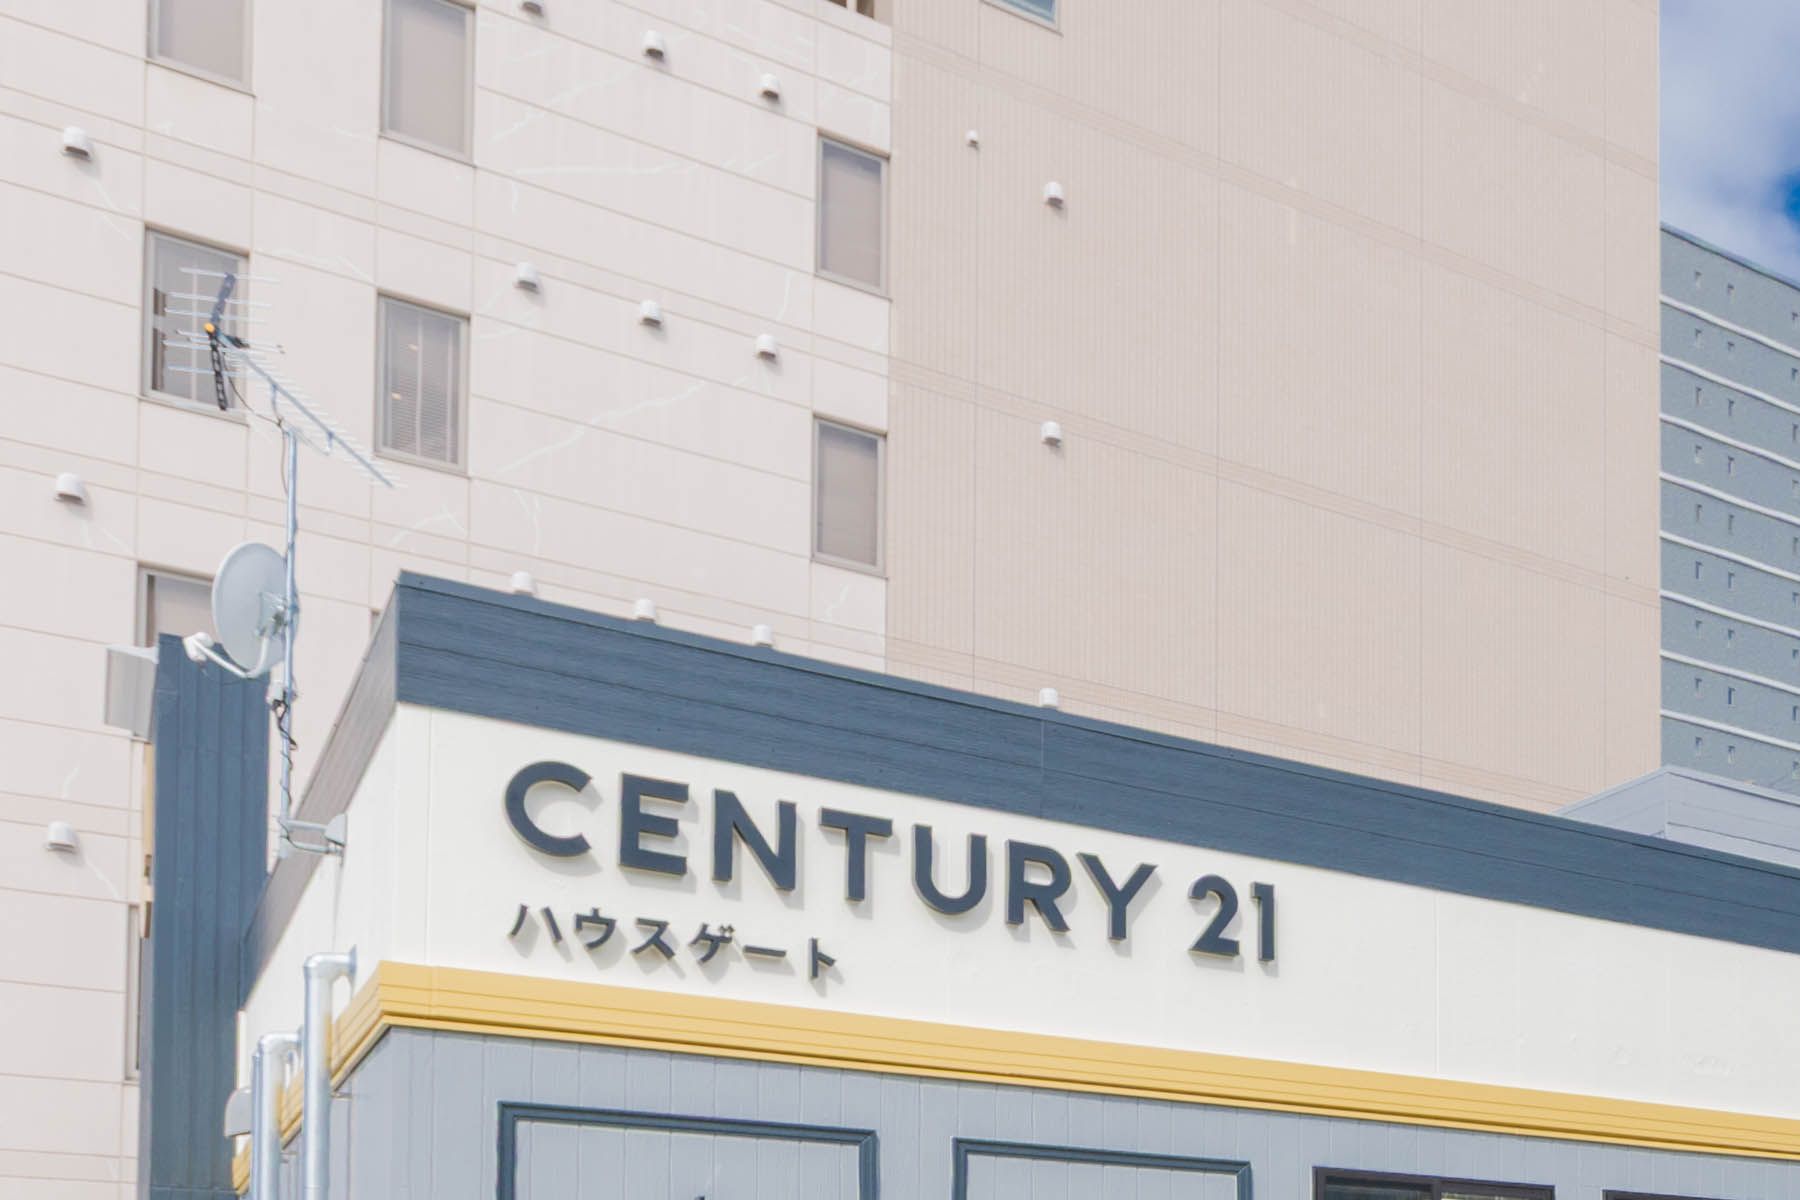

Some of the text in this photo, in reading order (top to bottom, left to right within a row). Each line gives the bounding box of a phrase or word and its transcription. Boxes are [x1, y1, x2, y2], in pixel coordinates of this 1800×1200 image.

[503, 759, 1276, 963] CENTURY 21
[509, 903, 838, 981] ハウスゲート
